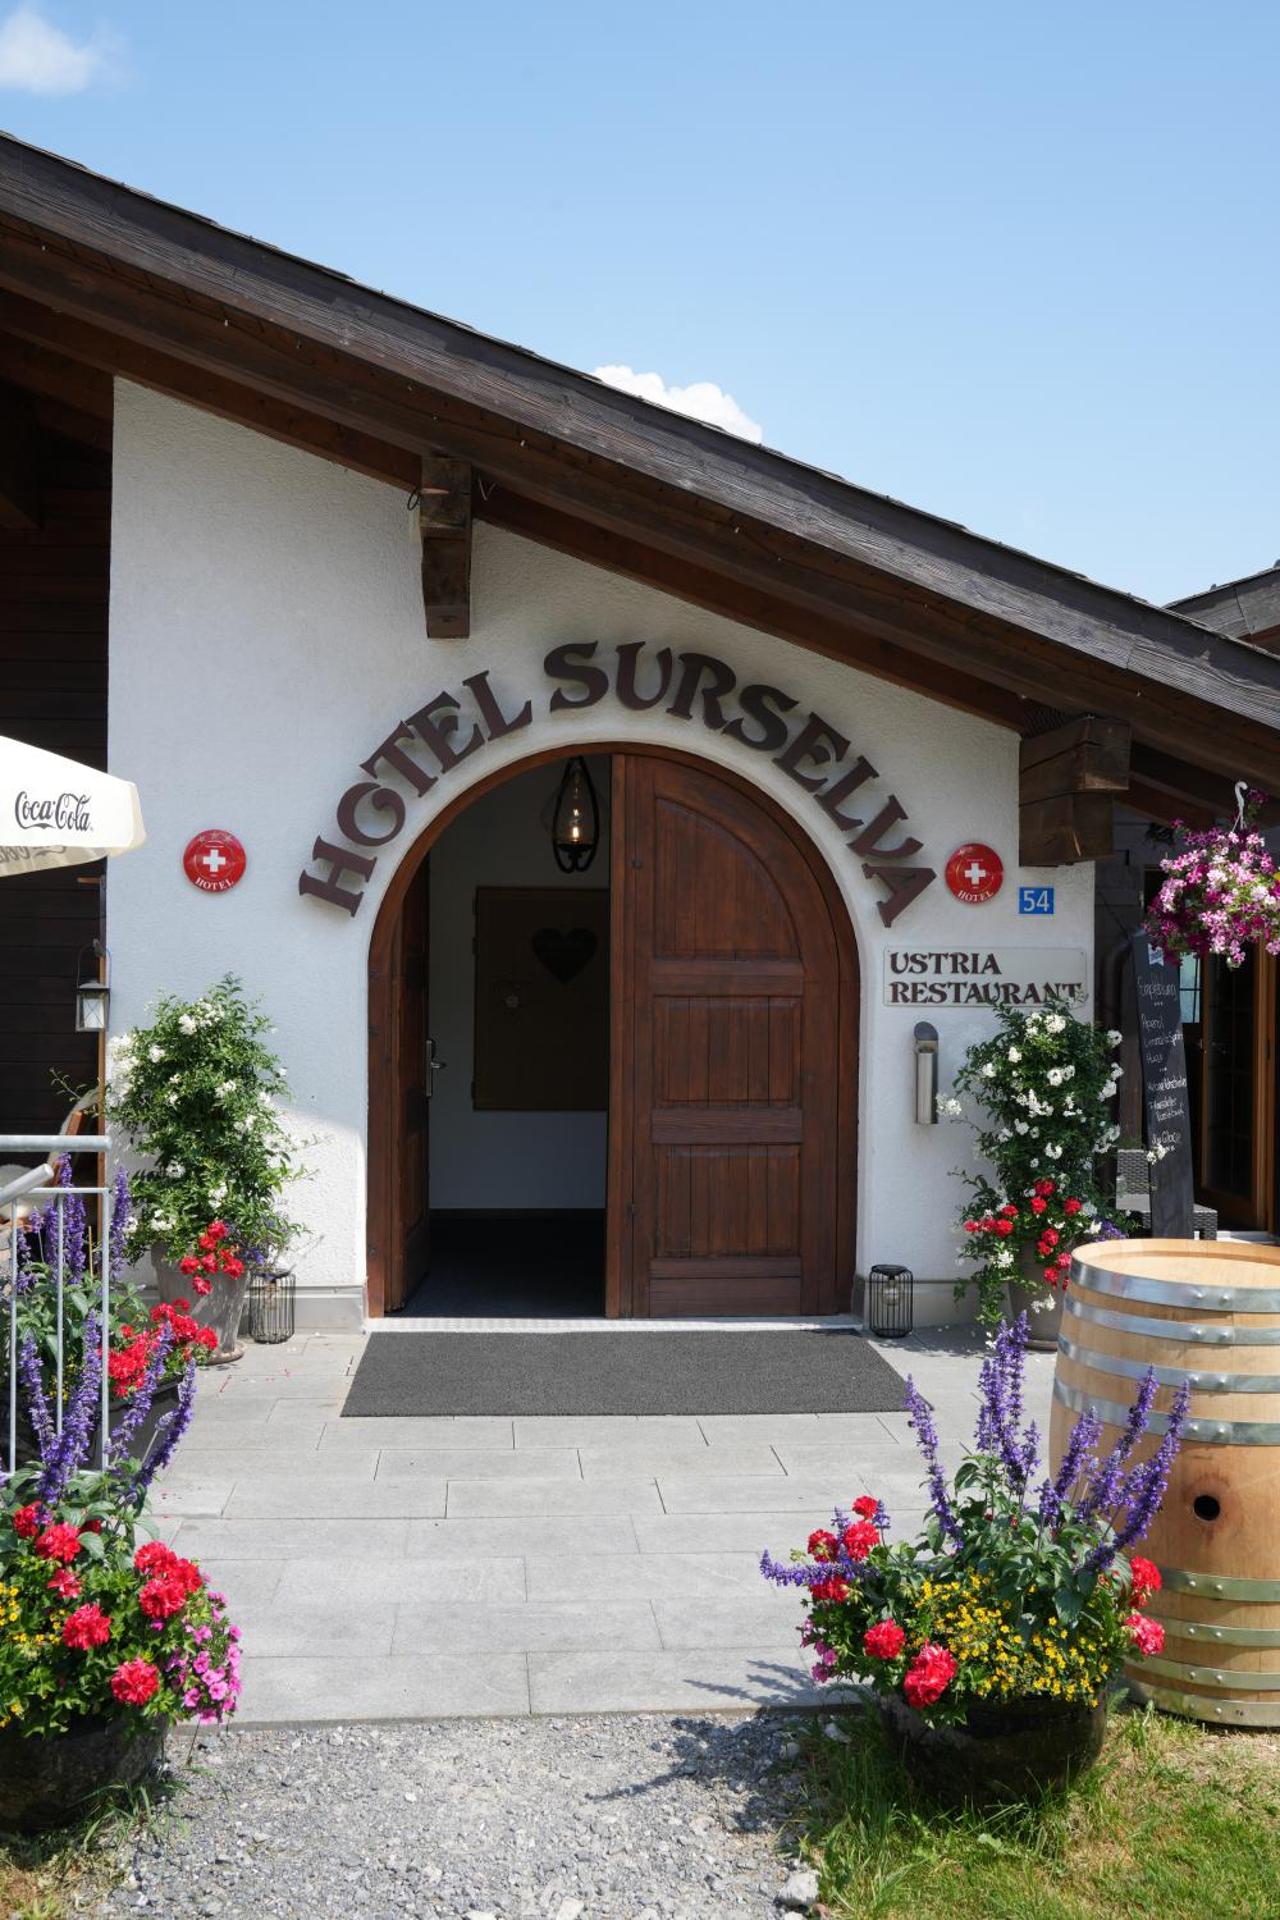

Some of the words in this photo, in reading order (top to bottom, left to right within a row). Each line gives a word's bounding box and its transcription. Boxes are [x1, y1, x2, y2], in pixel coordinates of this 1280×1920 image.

[299, 670, 532, 917] HOTEL
[544, 640, 938, 928] SURSELVA
[15, 791, 92, 831] Coca-Cola
[195, 877, 234, 890] HOTEL
[958, 890, 993, 902] HOTEL
[1023, 889, 1049, 912] 54
[890, 952, 1002, 975] USTRIA
